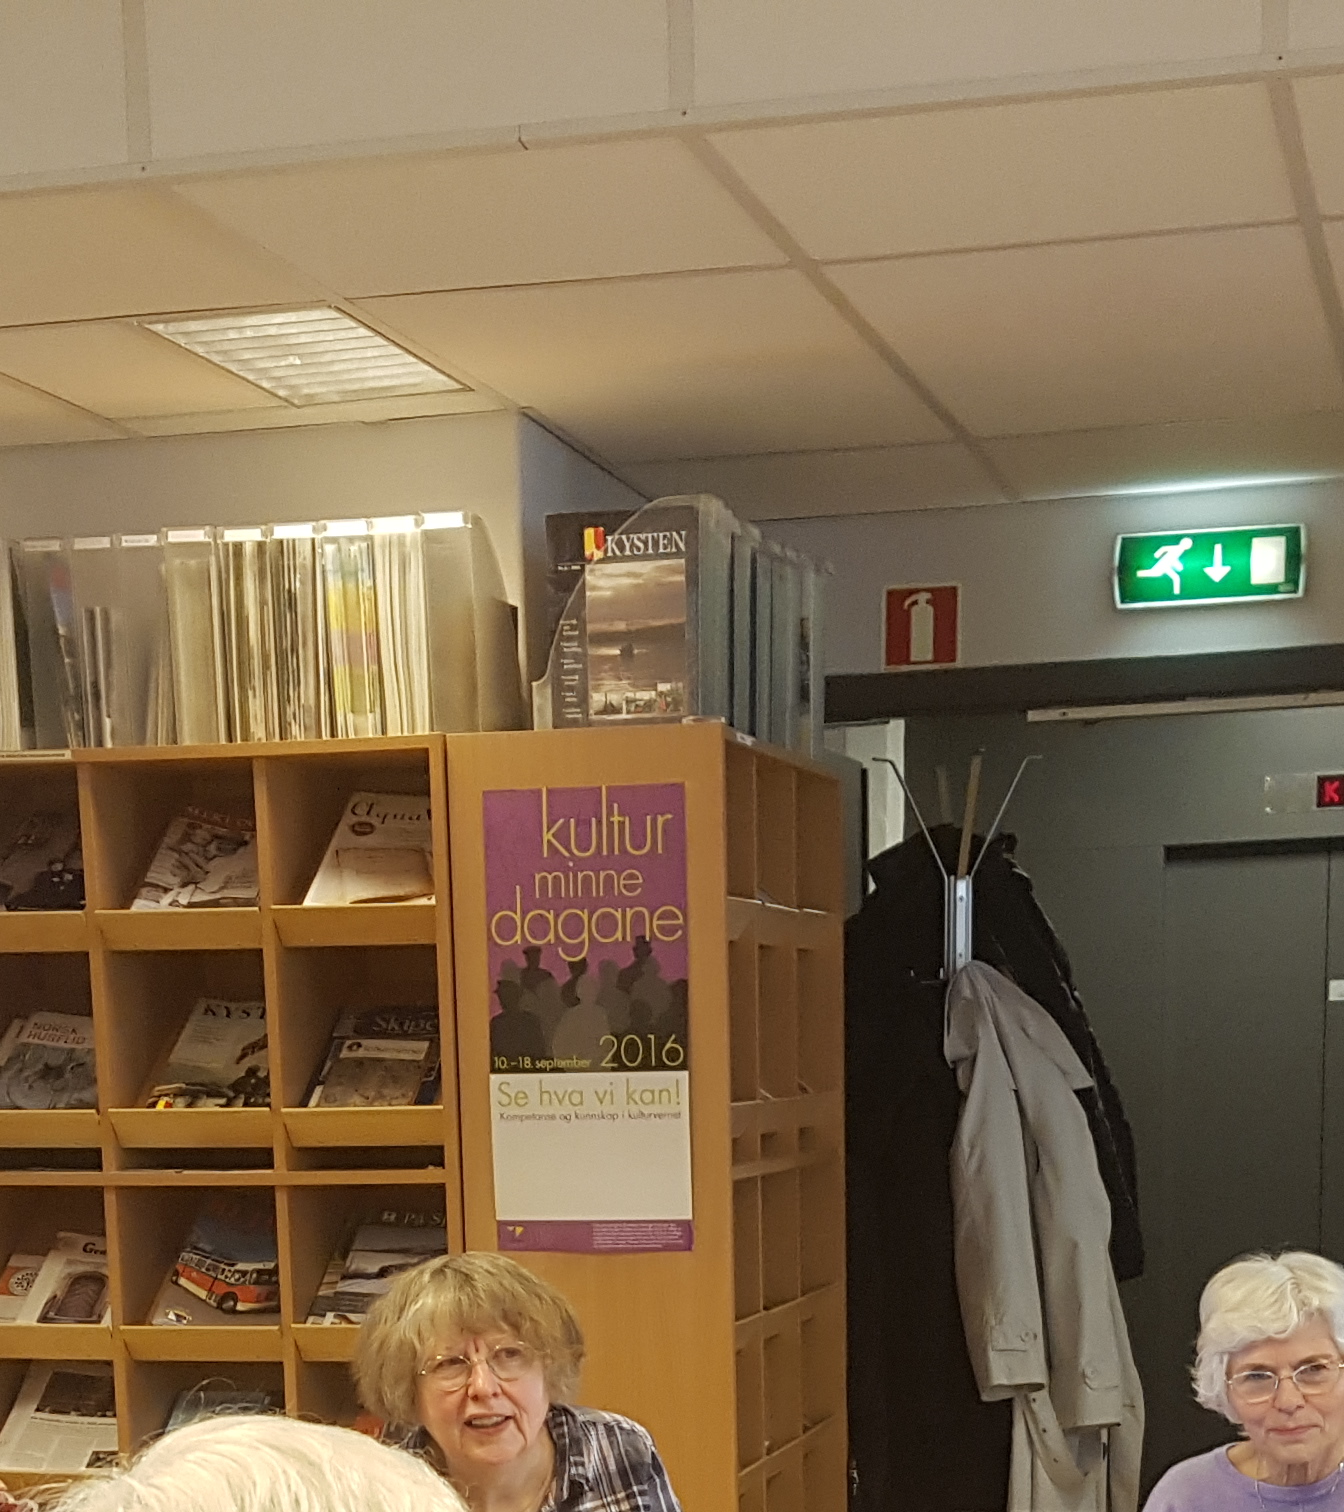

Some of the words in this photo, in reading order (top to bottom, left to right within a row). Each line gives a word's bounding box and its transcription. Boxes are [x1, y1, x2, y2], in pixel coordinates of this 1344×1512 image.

[606, 531, 687, 557] KYSTEN
[1323, 781, 1340, 802] K
[542, 785, 673, 859] kultur
[534, 861, 644, 899] minne
[491, 885, 684, 962] dagane
[535, 1055, 592, 1071] september
[599, 1034, 684, 1067] 2016
[497, 1081, 529, 1108] Se
[539, 1079, 584, 1107] hva
[594, 1081, 614, 1106] vi
[625, 1078, 681, 1106] kan!
[499, 1112, 556, 1123] Kompetanse
[559, 1113, 572, 1123] og
[574, 1110, 619, 1122] kunnskap
